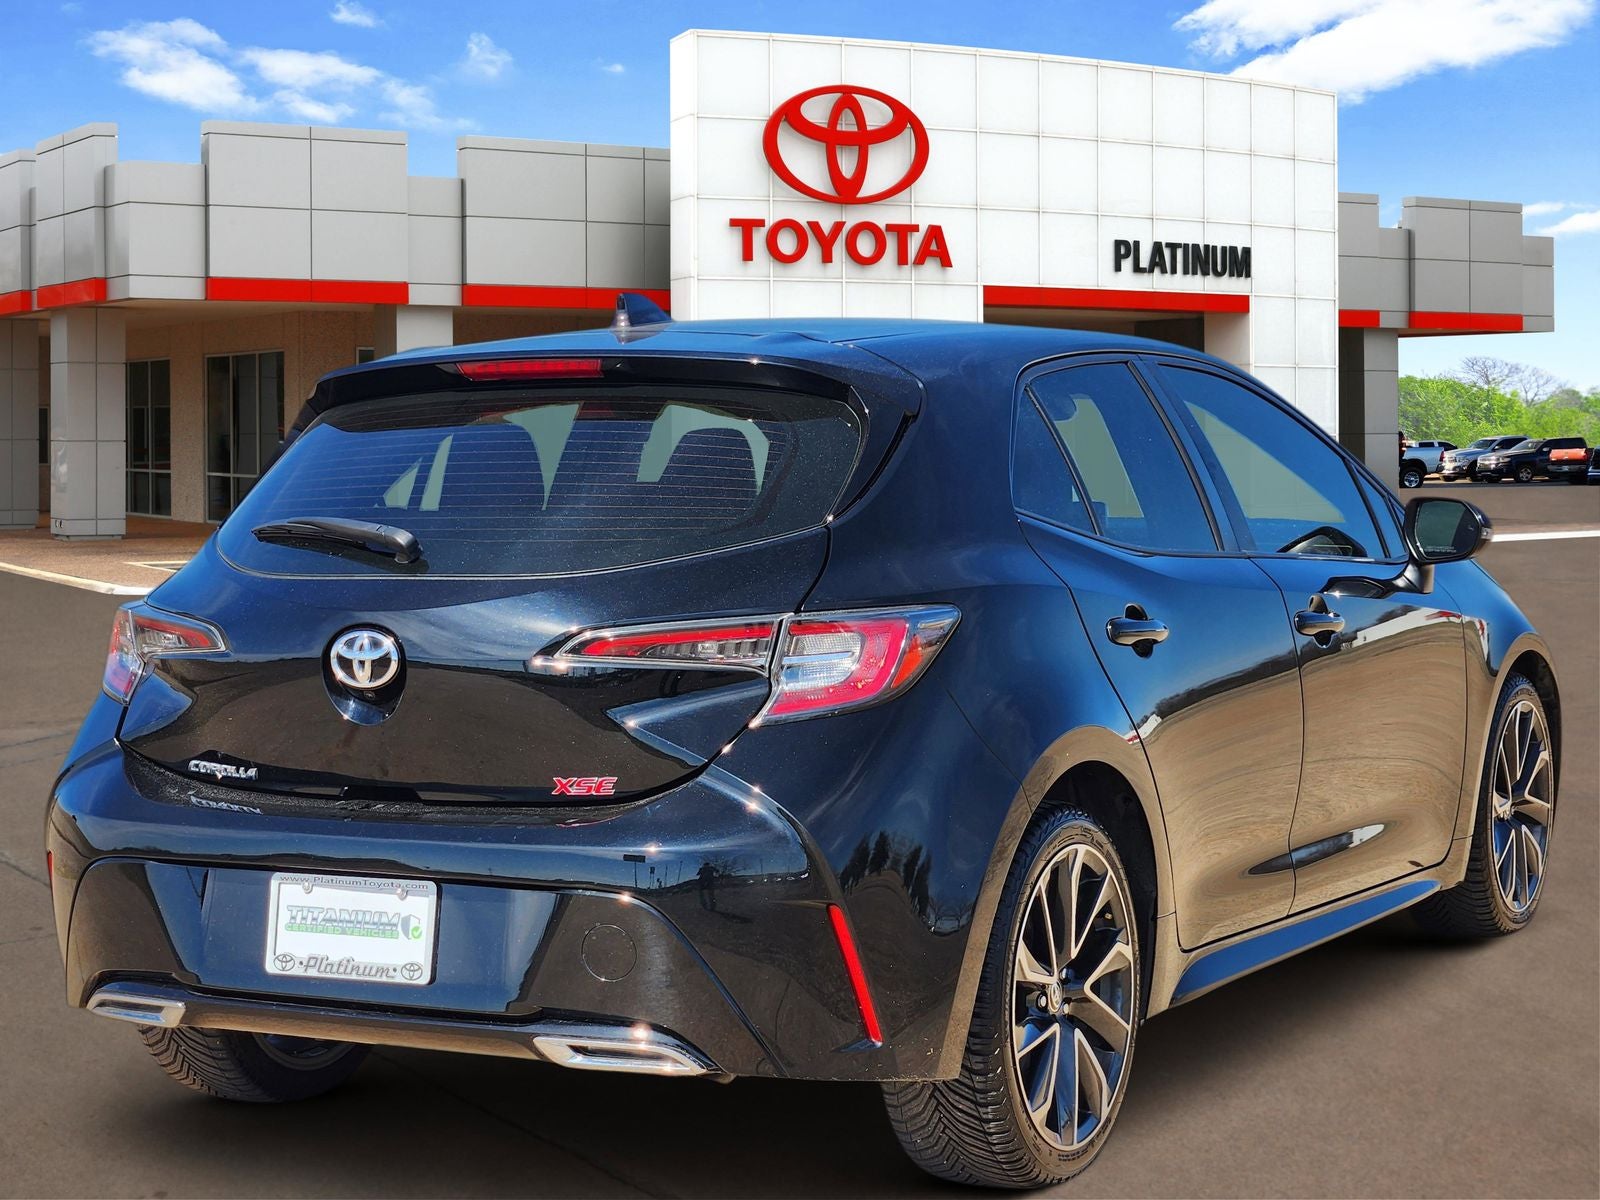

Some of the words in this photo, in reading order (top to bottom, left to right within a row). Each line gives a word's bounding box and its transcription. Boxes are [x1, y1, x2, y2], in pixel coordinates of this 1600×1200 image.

[729, 218, 953, 268] TOYOTA
[1114, 239, 1252, 278] PLATINUM
[188, 760, 258, 780] COROLLA
[551, 777, 618, 796] XSE
[280, 875, 429, 890] www.PlatinumToyota.com
[287, 905, 401, 930] TITANIUM
[285, 923, 341, 936] CERTIFIED
[345, 927, 399, 939] VEHICLES
[304, 953, 396, 978] Platinum
